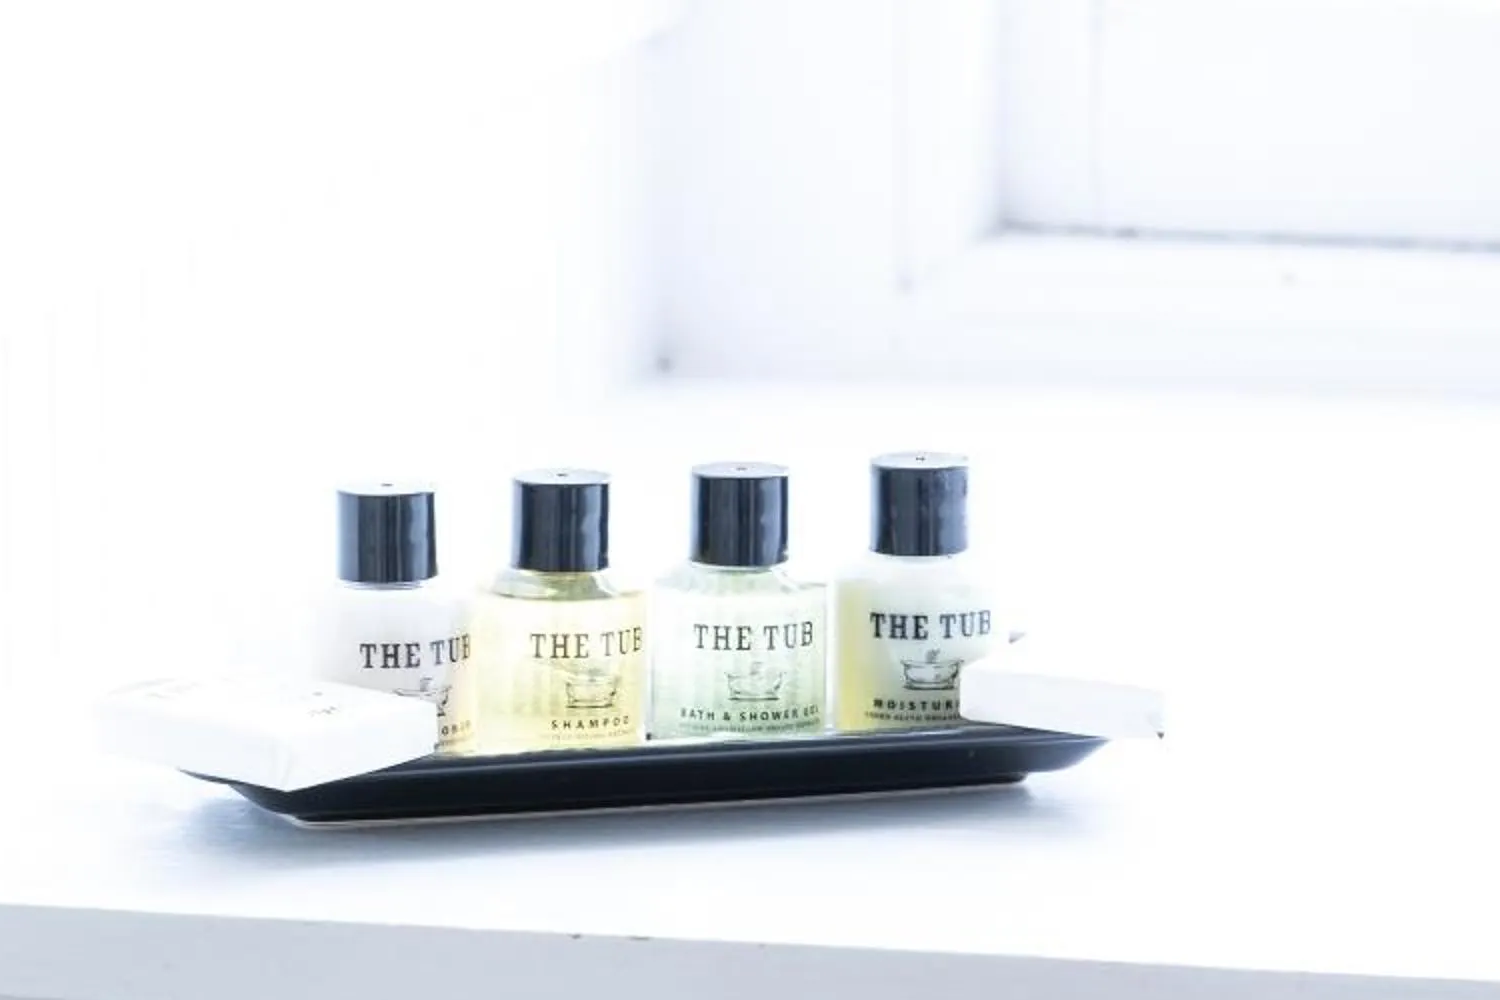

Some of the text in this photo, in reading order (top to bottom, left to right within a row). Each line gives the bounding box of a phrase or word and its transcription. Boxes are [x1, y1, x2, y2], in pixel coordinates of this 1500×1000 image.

[693, 620, 814, 651] THE TUB
[869, 609, 992, 641] THE TUB
[359, 632, 471, 669] THE TUB
[529, 625, 642, 659] THE TUB
[680, 707, 716, 721] BATH
[722, 711, 732, 722] &
[739, 707, 800, 722] SHOWER
[872, 697, 961, 712] MOISTURI
[550, 714, 630, 730] SHAMPOO
